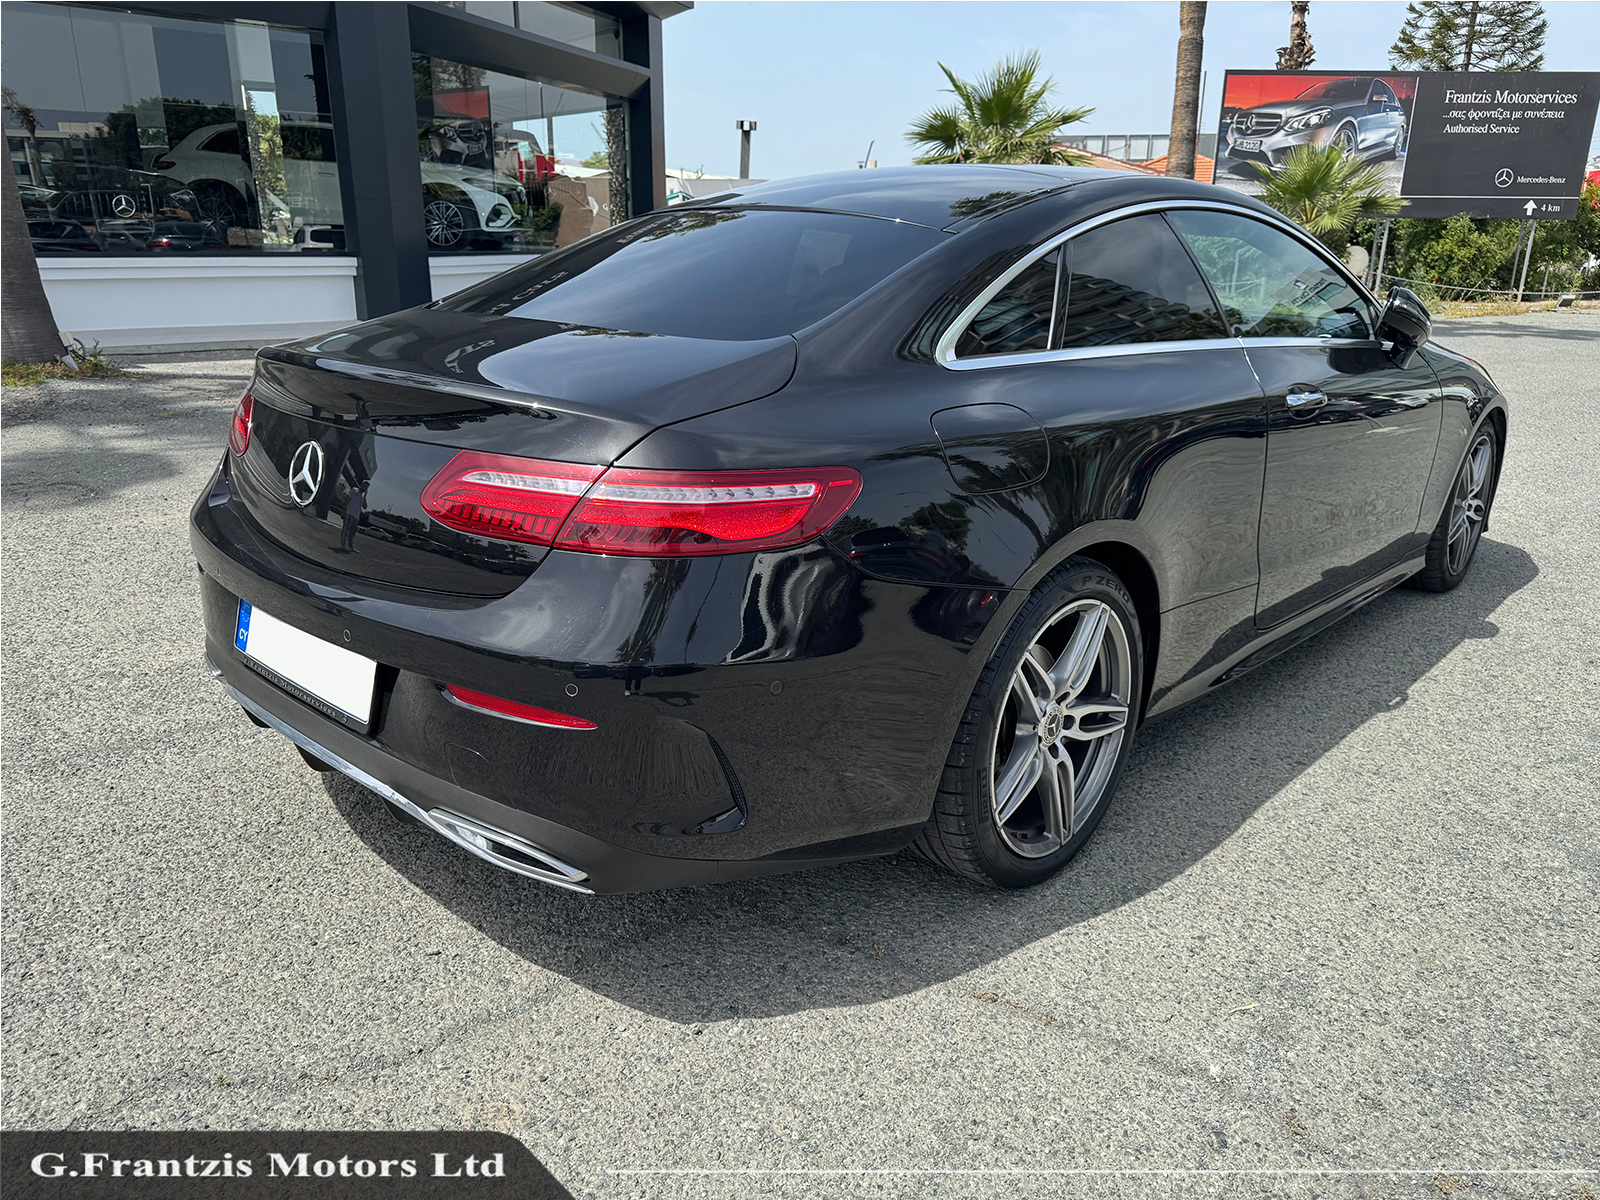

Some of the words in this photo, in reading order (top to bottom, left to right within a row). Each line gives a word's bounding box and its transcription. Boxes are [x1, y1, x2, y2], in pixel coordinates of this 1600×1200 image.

[1444, 90, 1492, 104] Frantzis
[1494, 90, 1578, 104] Motorservices
[1511, 110, 1523, 121] με
[1524, 108, 1565, 119] συνέπεια
[1443, 123, 1488, 134] Authorised
[1489, 123, 1520, 134] Service
[1516, 176, 1566, 184] Mercedes-Benz
[1540, 203, 1546, 212] 4
[1547, 203, 1561, 212] km
[1081, 575, 1093, 587] P
[1095, 575, 1131, 604] ZERO
[239, 628, 249, 642] CY
[977, 766, 989, 825] PIRELLI
